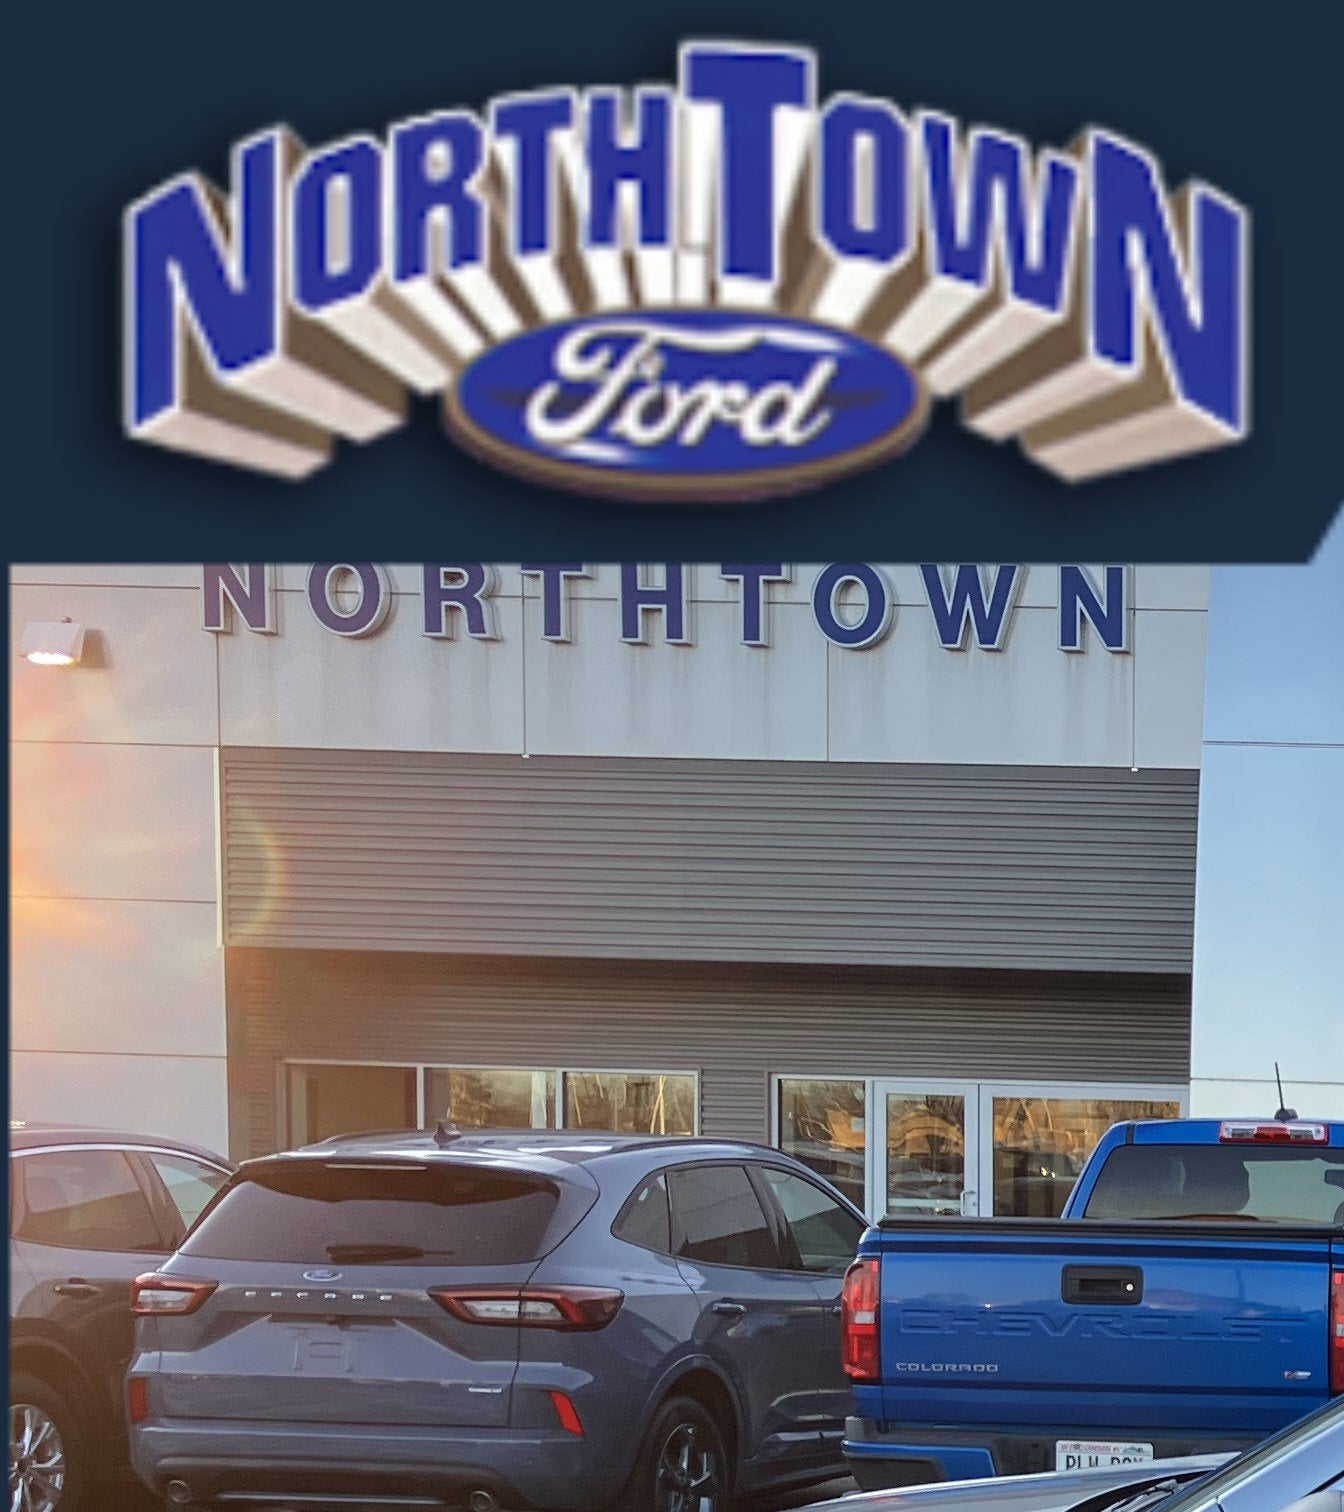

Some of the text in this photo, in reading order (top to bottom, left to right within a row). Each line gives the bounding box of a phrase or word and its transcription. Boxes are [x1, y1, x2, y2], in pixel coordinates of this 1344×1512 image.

[202, 562, 1132, 654] NORTHTOWN
[900, 1308, 1307, 1343] CHEVROLET
[896, 1362, 999, 1373] COLORADO
